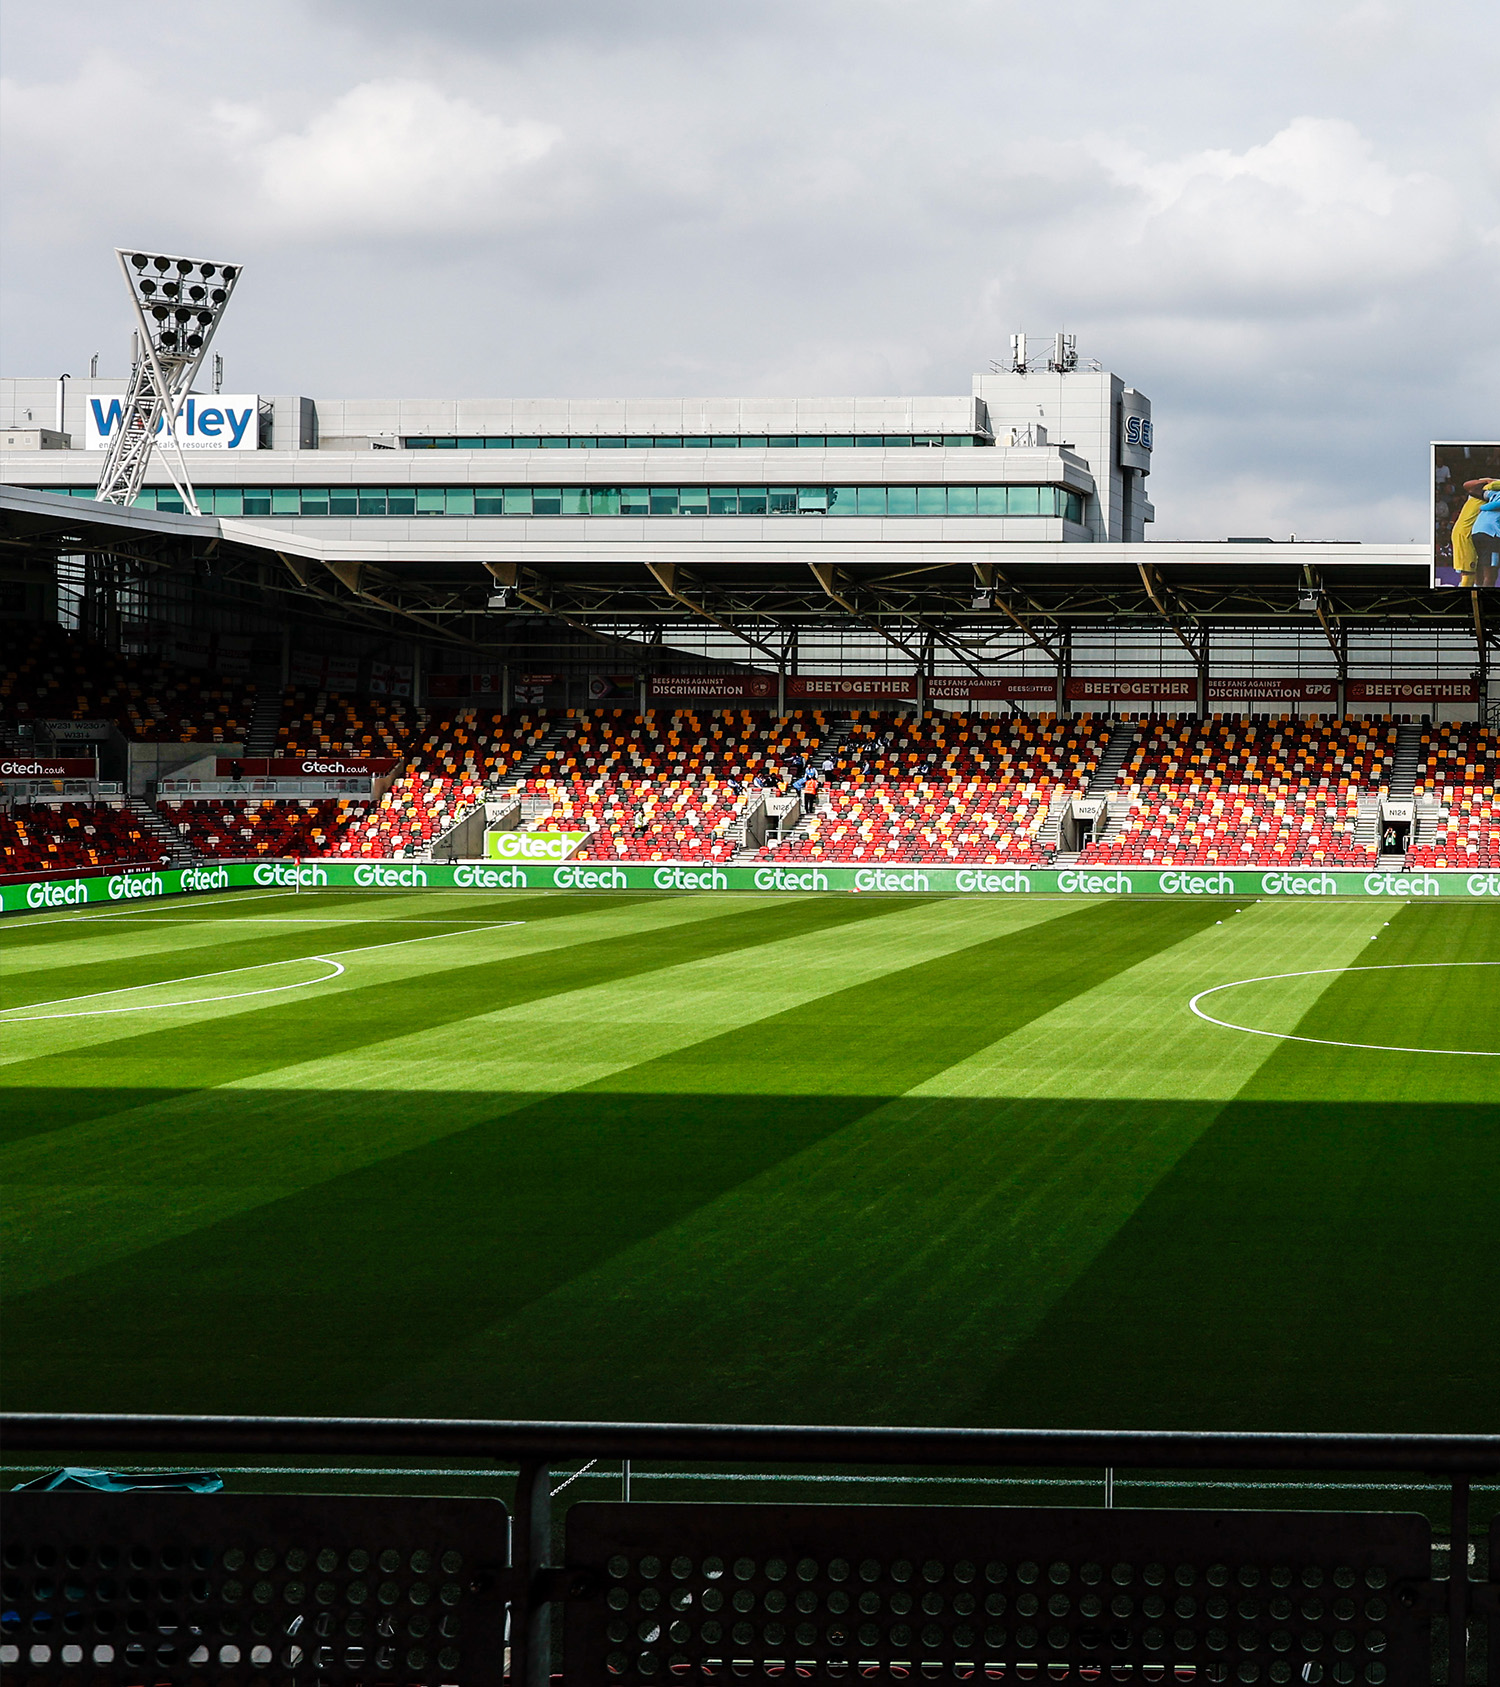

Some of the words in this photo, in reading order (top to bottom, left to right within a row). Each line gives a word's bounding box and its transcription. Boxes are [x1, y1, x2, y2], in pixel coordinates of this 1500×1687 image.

[652, 677, 670, 685] BEES
[671, 677, 690, 685] FANS
[691, 677, 724, 685] AGAINST
[929, 679, 947, 687] BEES
[948, 679, 967, 687] FANS
[968, 679, 1002, 687] AGAINST
[1208, 680, 1227, 688] BEES
[1228, 680, 1247, 688] FANS
[1248, 680, 1282, 688] AGAINST
[652, 685, 743, 695] DISCRIMINATION
[929, 687, 970, 697] RACISM
[1208, 688, 1301, 698] DISCRIMINATION
[1, 761, 65, 775] Gtech.co.uk
[301, 760, 369, 774] Gtech.co.uk
[497, 833, 577, 858] Gtech
[27, 879, 88, 908] Gtech
[108, 872, 162, 899] Gtech
[181, 866, 228, 890] Gtech
[254, 863, 327, 888] Gtech
[354, 864, 427, 887] Gtech
[454, 865, 526, 888] Gtech
[554, 866, 626, 889] Gtech
[654, 867, 727, 890] Gtech
[754, 868, 827, 891] Gtech
[855, 869, 929, 893] Gtech
[956, 870, 1030, 893] Gtech
[1057, 871, 1132, 894] Gtech
[1159, 872, 1234, 894] Gtech
[1262, 872, 1336, 896] Gtech
[1364, 872, 1440, 897] Gtech
